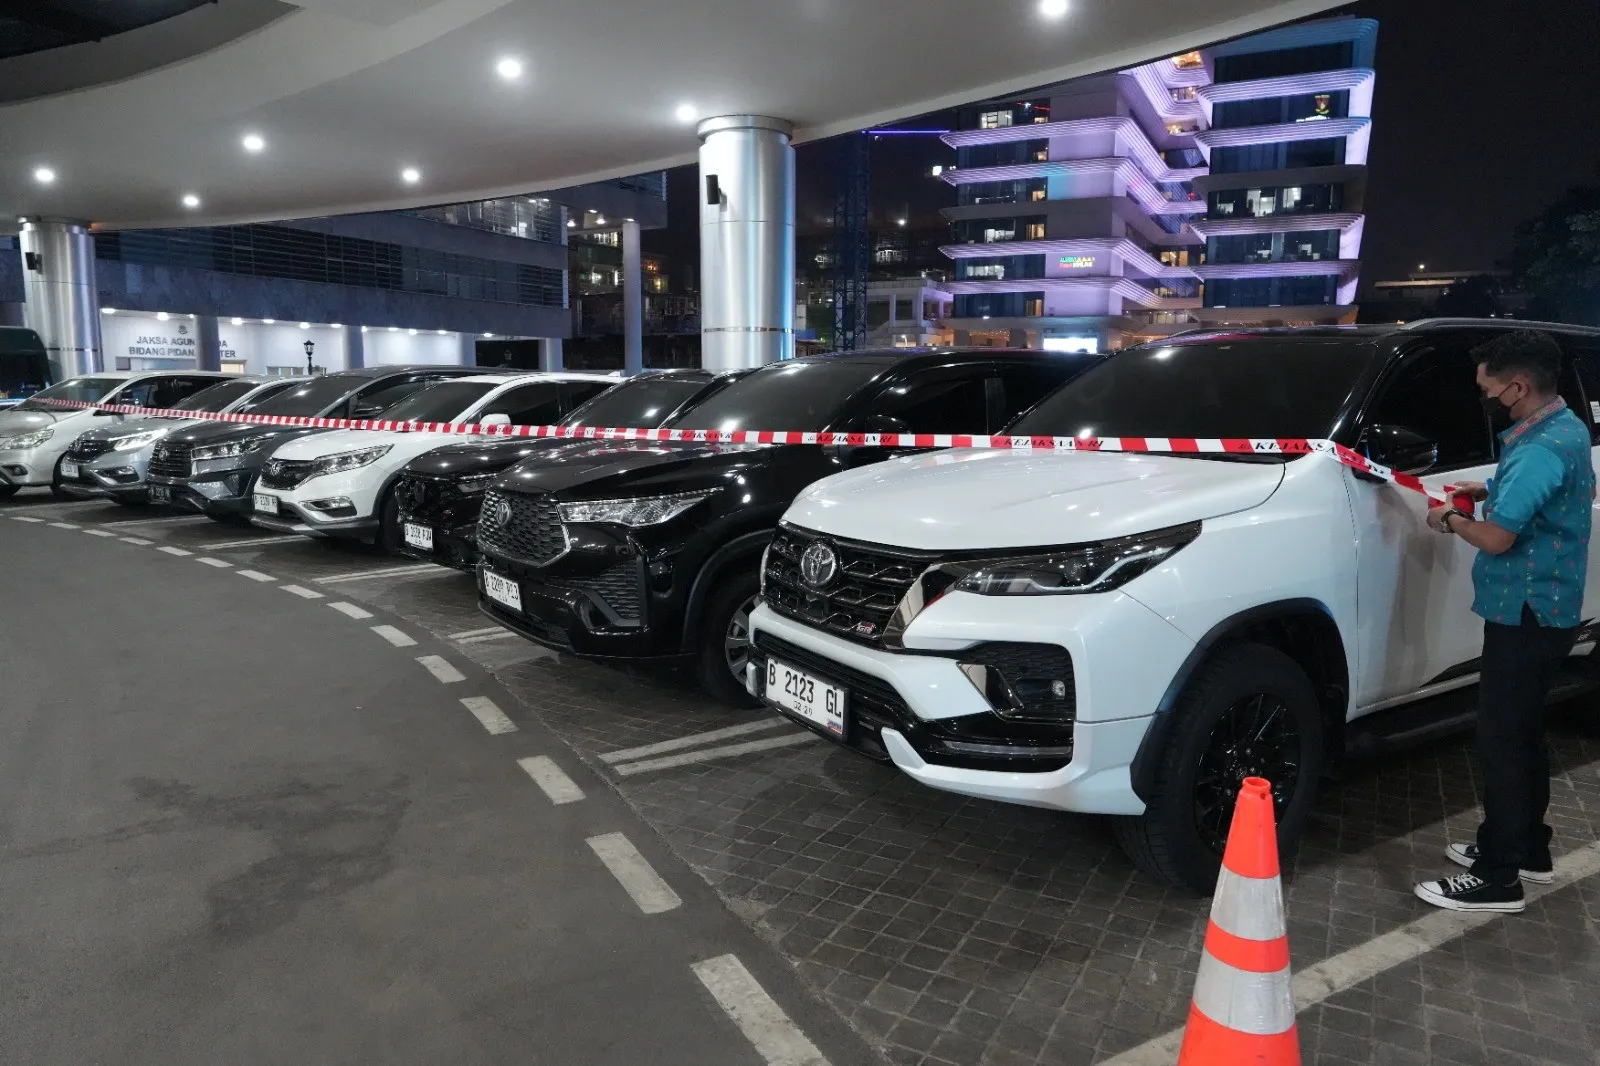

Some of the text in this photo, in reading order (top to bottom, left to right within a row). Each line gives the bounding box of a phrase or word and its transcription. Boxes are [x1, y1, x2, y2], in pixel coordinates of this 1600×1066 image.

[136, 336, 168, 345] JAKSA
[171, 338, 196, 346] AGUN
[129, 347, 236, 358] BIDANG PIDAN TER
[769, 663, 842, 718] B 2123 GL
